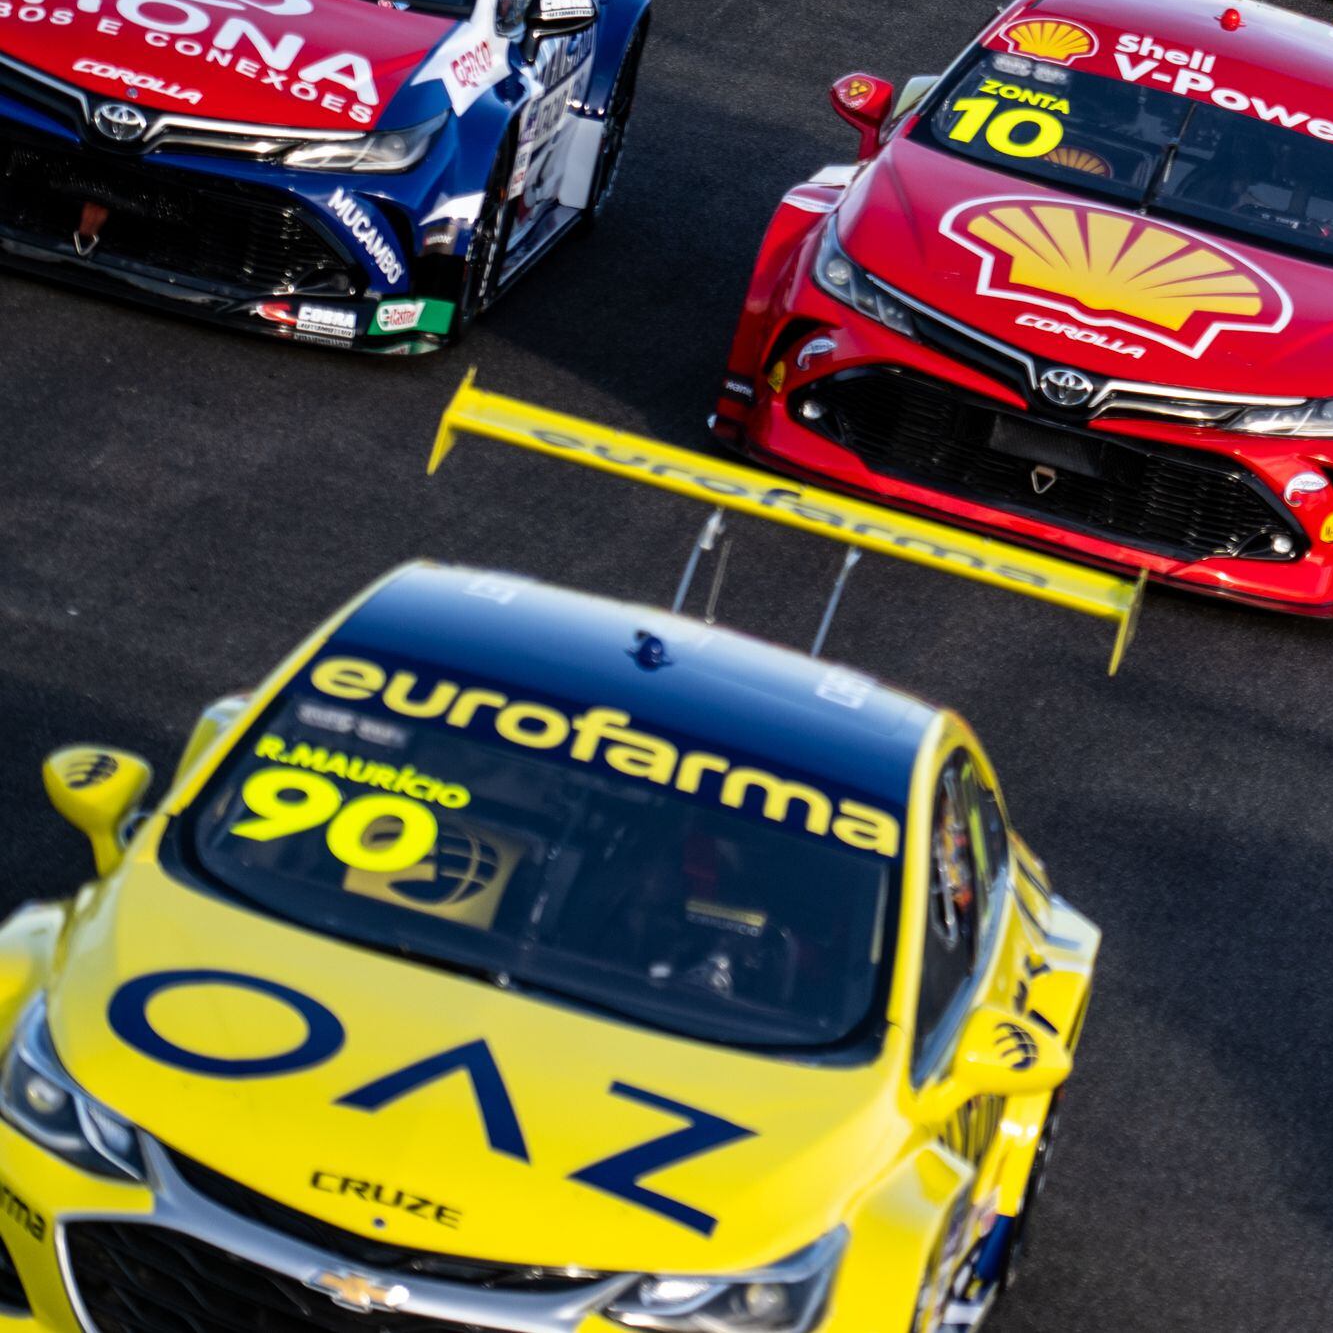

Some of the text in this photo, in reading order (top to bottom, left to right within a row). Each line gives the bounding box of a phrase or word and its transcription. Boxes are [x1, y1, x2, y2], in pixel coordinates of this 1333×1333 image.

[72, 58, 203, 104] COROLLA
[1113, 32, 1216, 73] Shell
[949, 97, 1064, 158] 10
[978, 79, 1070, 115] ZONTA
[328, 186, 403, 285] MUCAMBO
[1014, 312, 1146, 359] COROLLA
[529, 428, 1047, 587] eurofarma
[254, 733, 470, 810] R.MAURÍCIO
[310, 656, 900, 858] eurofarma
[230, 766, 438, 872] 90
[311, 1170, 461, 1228] CRUZE
